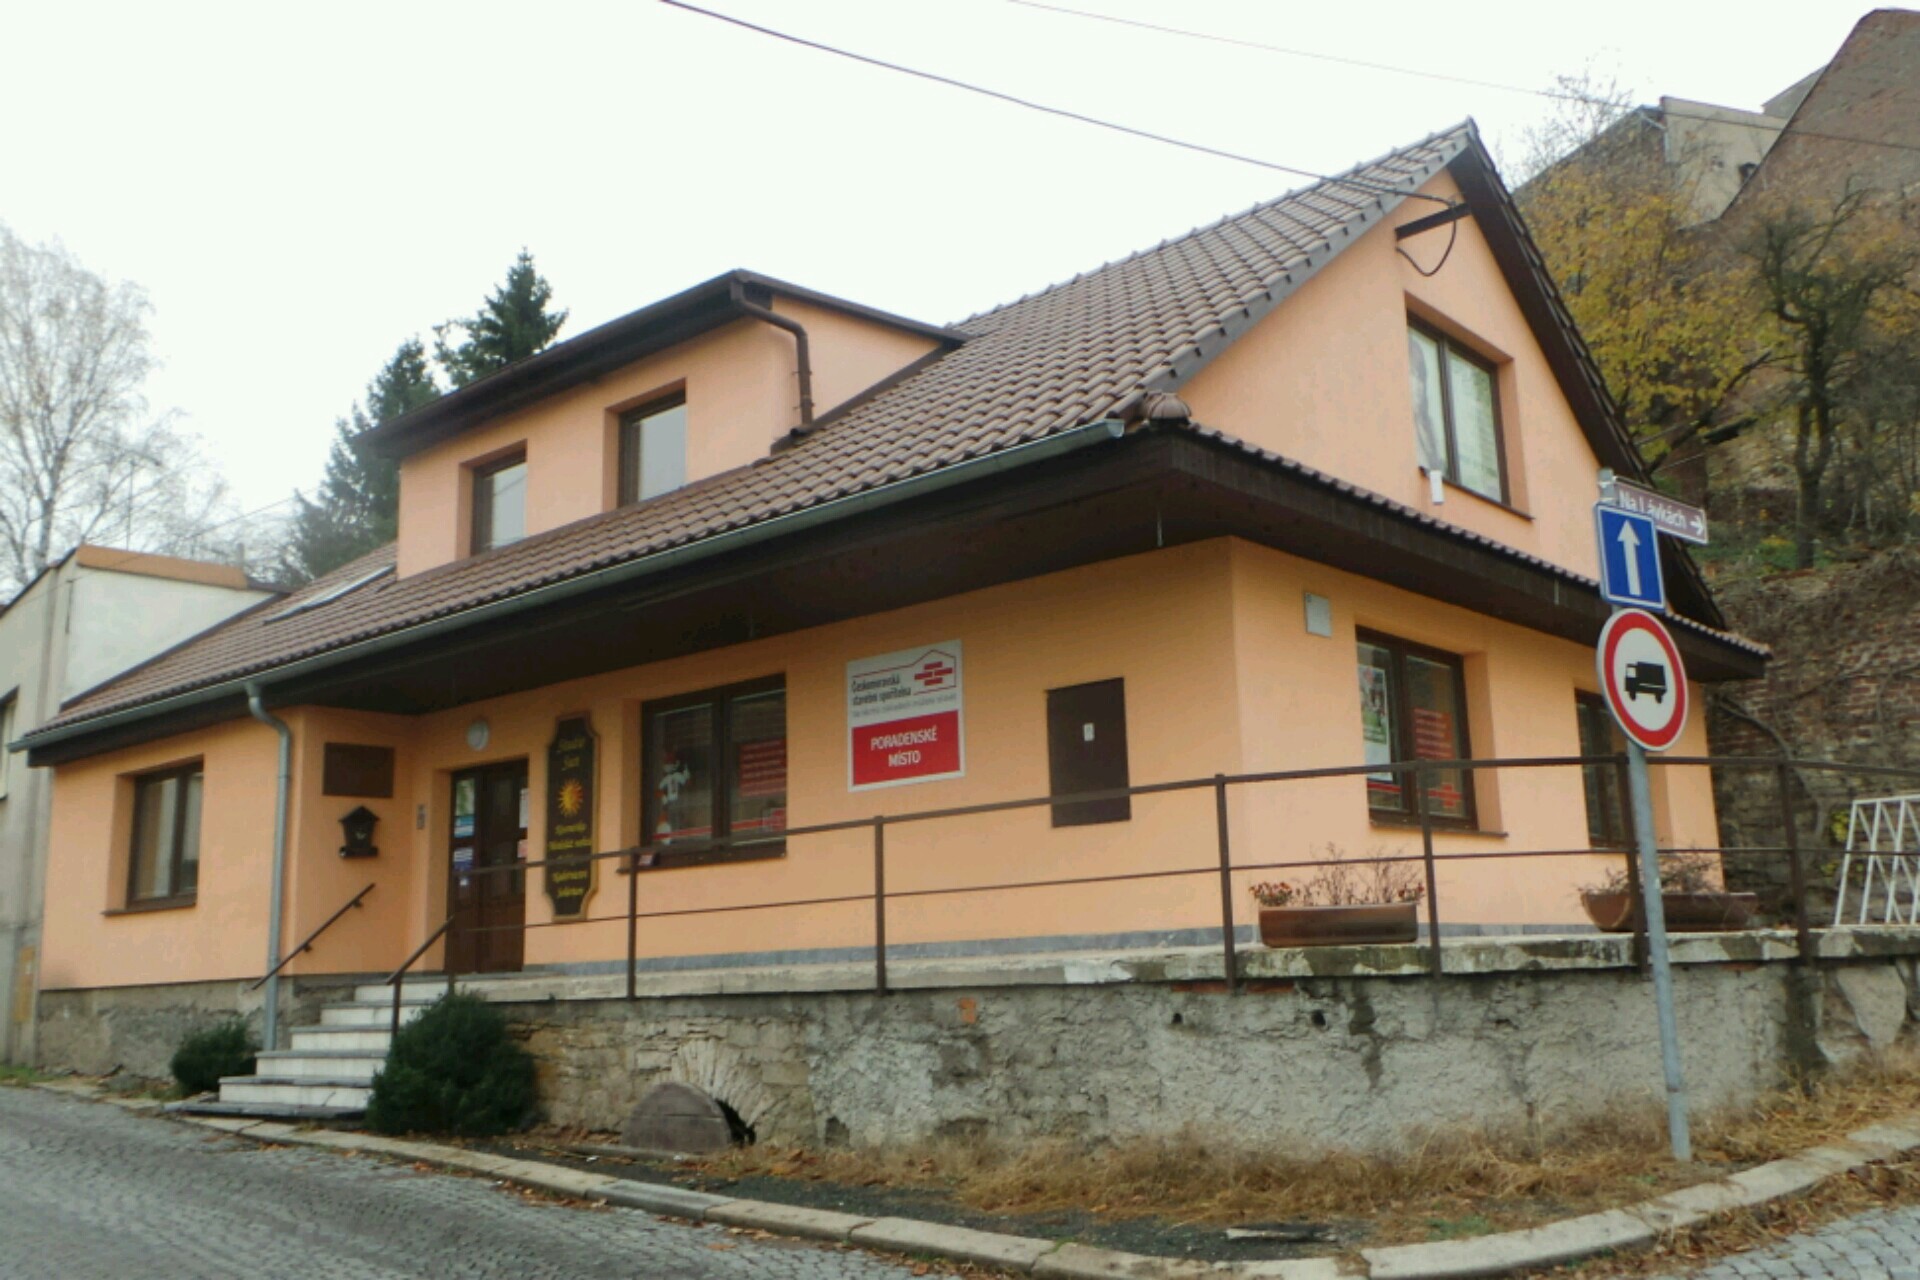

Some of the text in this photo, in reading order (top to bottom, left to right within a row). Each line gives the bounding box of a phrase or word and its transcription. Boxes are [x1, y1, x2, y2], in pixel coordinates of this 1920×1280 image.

[1619, 489, 1637, 512] Na
[870, 725, 938, 751] PORADENSKÉ
[888, 750, 921, 768] MÍSTO
